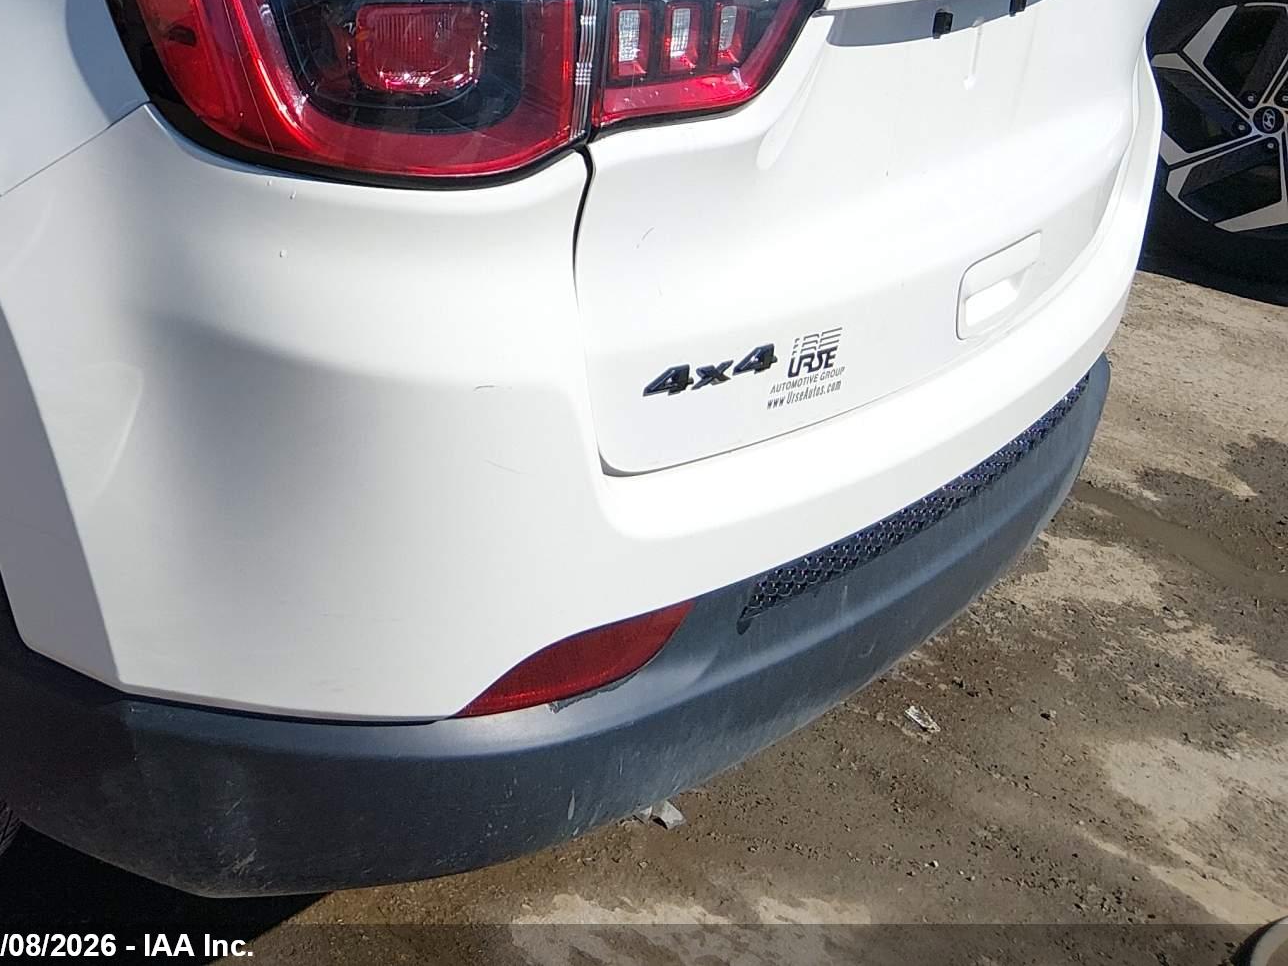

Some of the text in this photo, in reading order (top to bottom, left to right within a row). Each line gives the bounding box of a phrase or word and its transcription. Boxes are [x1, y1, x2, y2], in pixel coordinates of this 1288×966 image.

[642, 342, 778, 397] 4x4
[787, 345, 840, 378] URSE
[769, 366, 846, 395] AUTOMOTIVE GROUP
